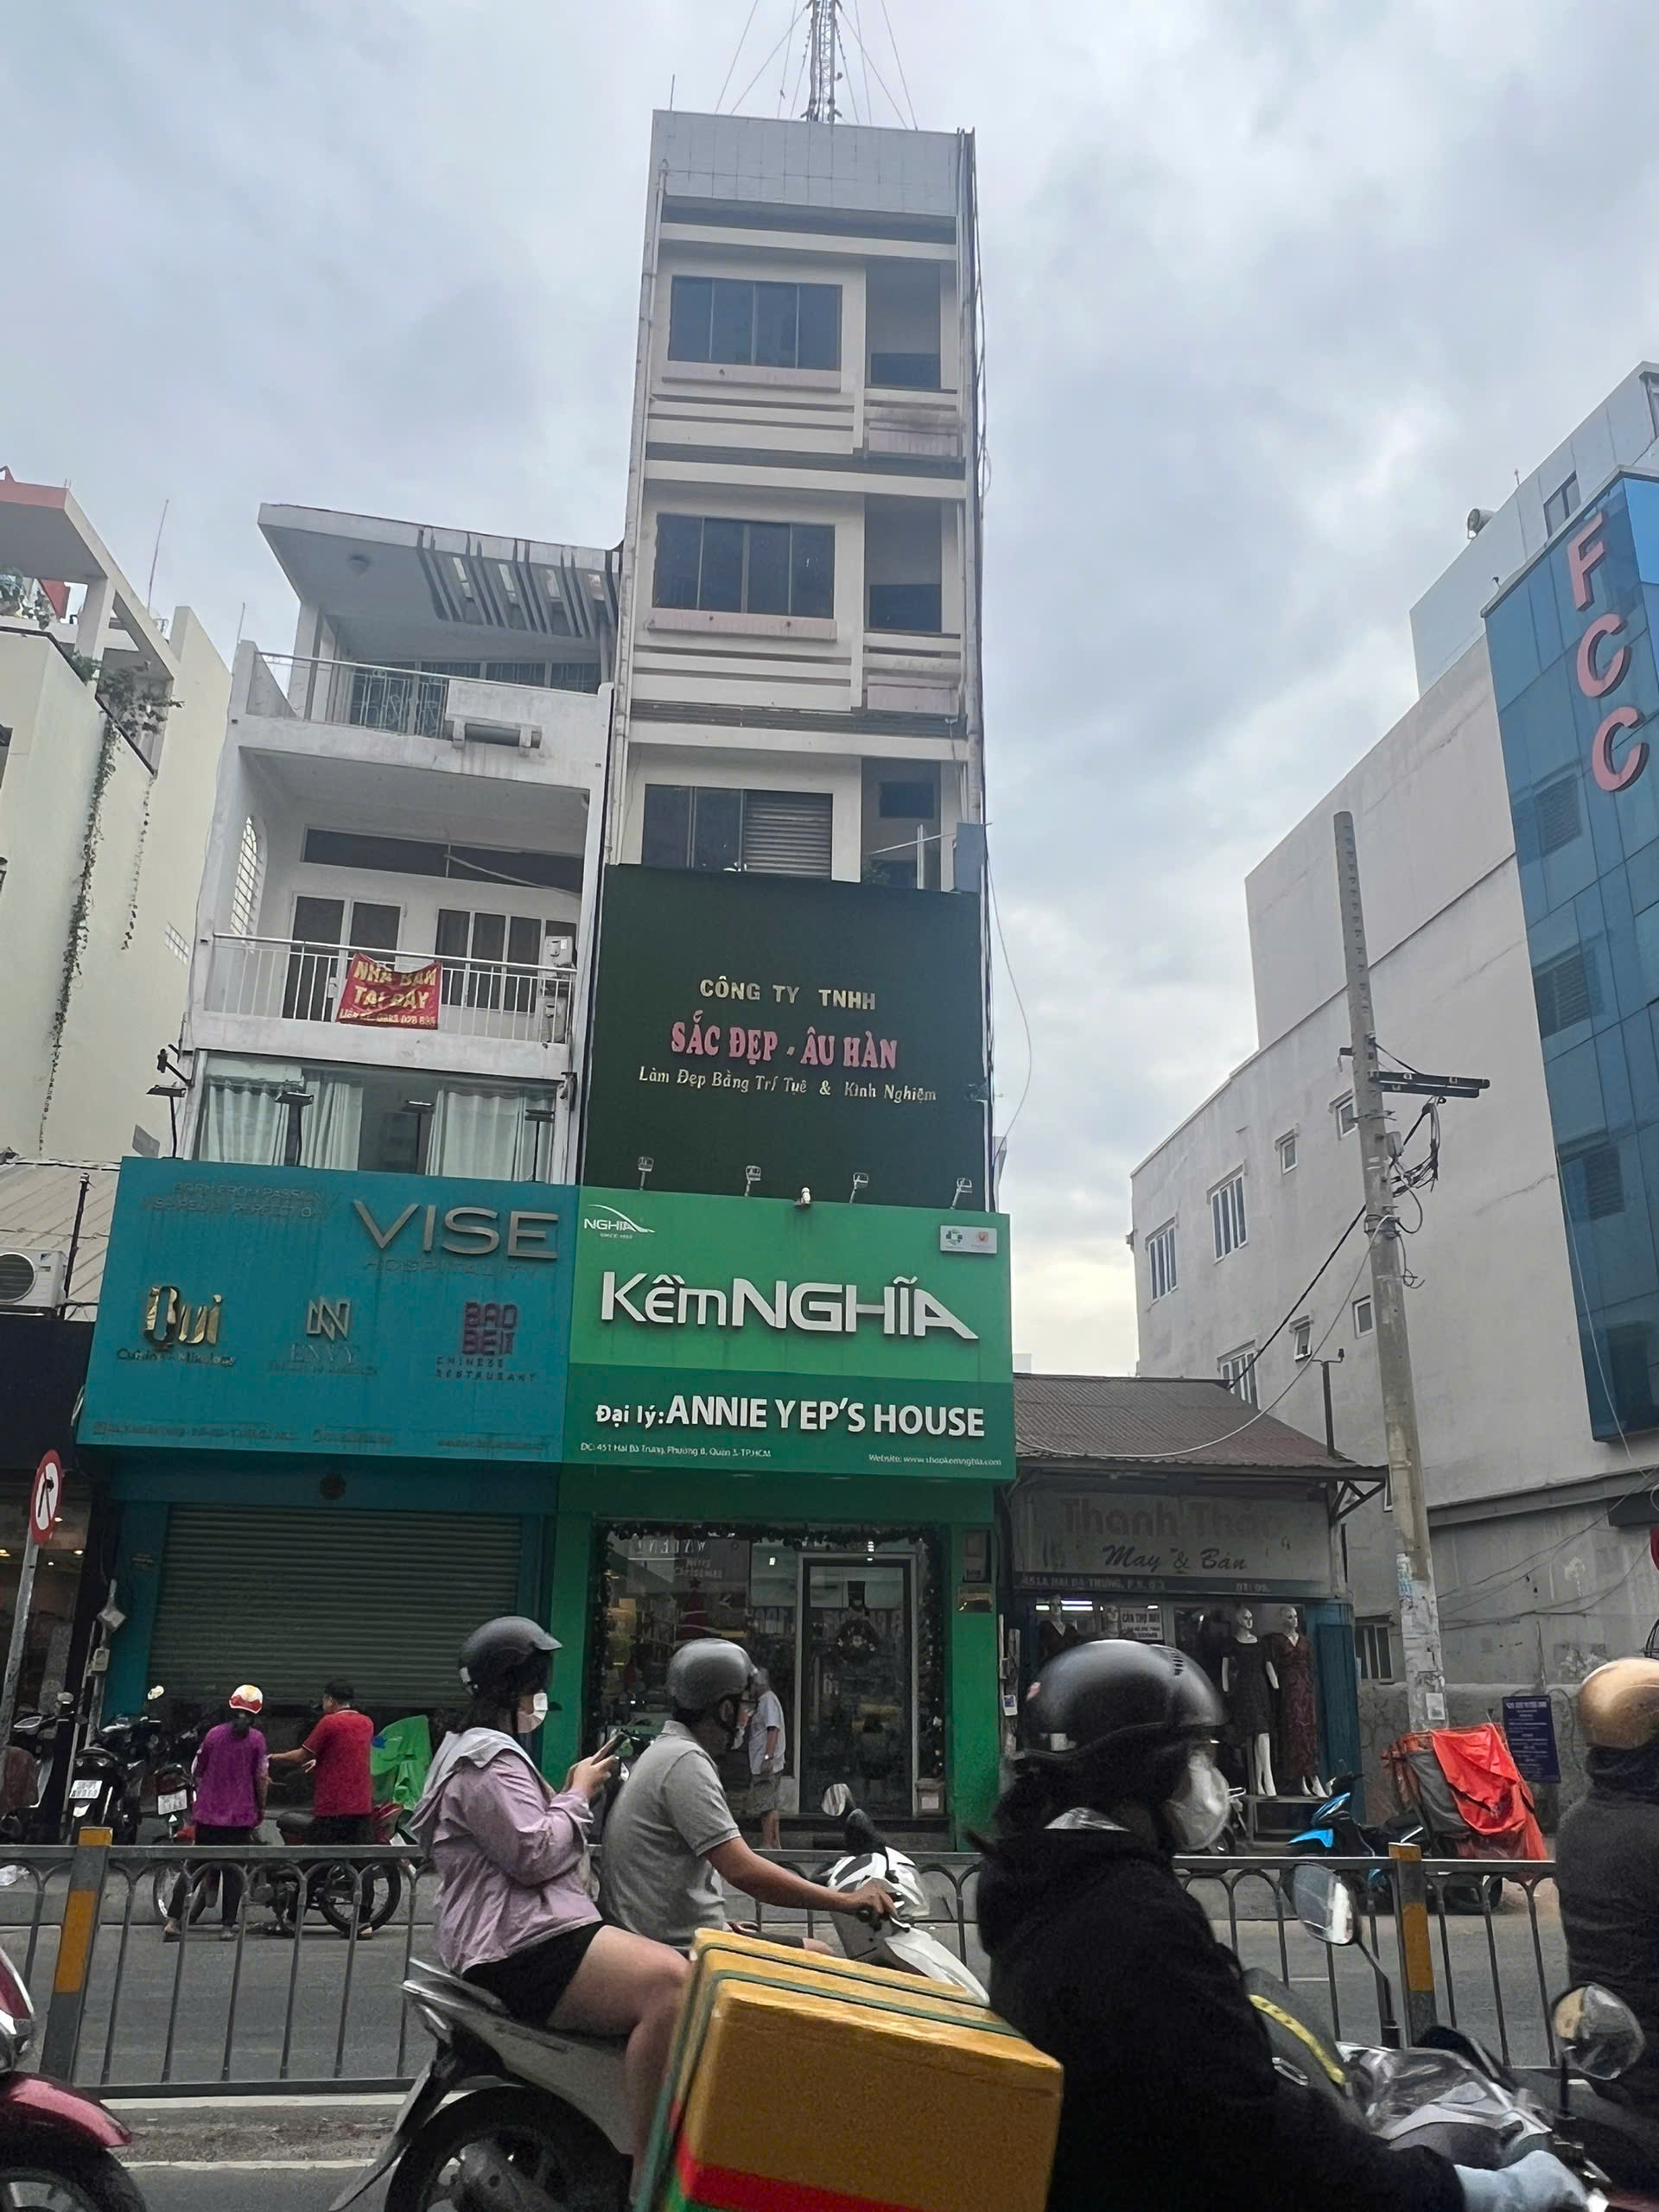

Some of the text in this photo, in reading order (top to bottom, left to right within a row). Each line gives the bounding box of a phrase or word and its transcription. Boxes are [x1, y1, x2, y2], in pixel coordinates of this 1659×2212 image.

[1567, 510, 1650, 792] FCC
[700, 976, 876, 1010] CÔNG TY TNHH
[671, 1010, 721, 1056] SẮC
[728, 1027, 777, 1065] ĐẸP
[800, 1027, 836, 1066] ÂU
[842, 1030, 898, 1070] HÀN
[639, 1065, 670, 1084] Làm
[677, 1069, 706, 1089] Đẹp
[711, 1069, 750, 1093] Bằng
[819, 1080, 831, 1096] &
[884, 1084, 937, 1103] Nghiệm
[353, 1199, 560, 1261] VISE
[595, 1403, 630, 1424] Đại
[666, 1395, 768, 1429] ANNIE
[874, 1403, 985, 1437] HOUSE
[596, 1443, 612, 1452] 451
[1102, 1545, 1161, 1573] May
[1199, 1548, 1247, 1570] Bán
